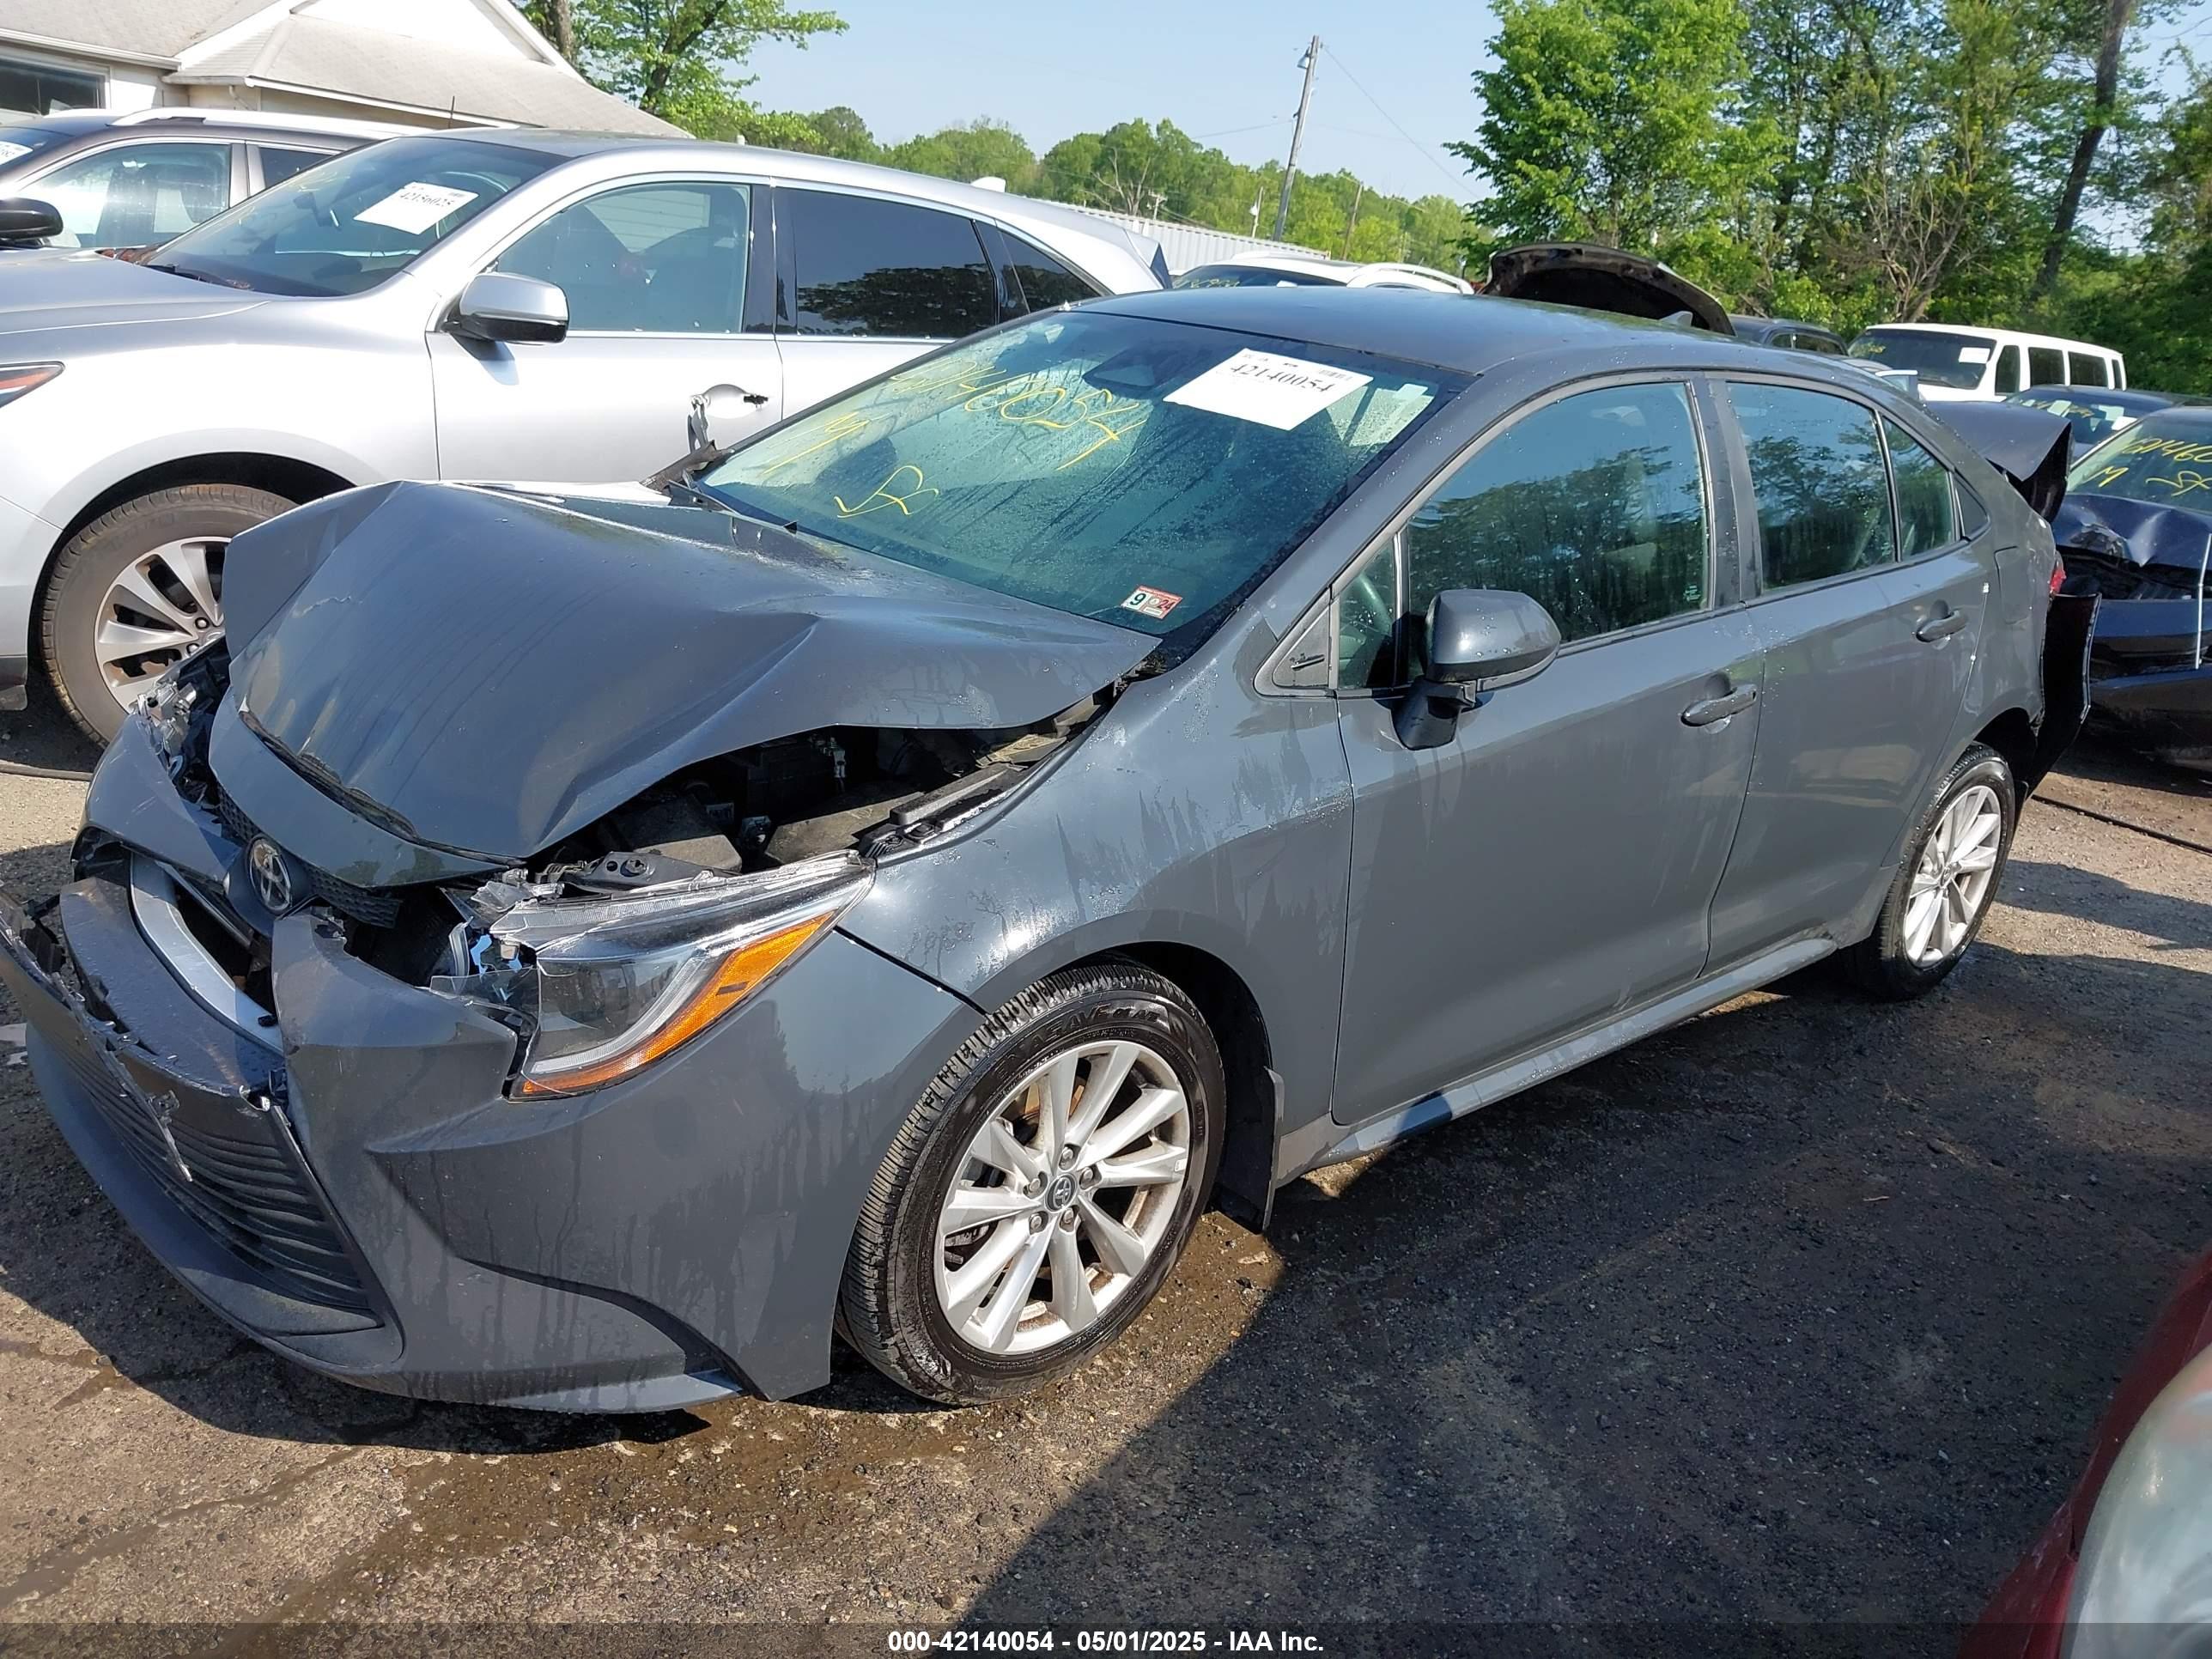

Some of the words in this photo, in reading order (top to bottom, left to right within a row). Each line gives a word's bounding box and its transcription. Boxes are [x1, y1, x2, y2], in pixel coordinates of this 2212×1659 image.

[1230, 363, 1335, 392] 42140054
[1129, 592, 1147, 606] 9
[1157, 599, 1176, 611] 24
